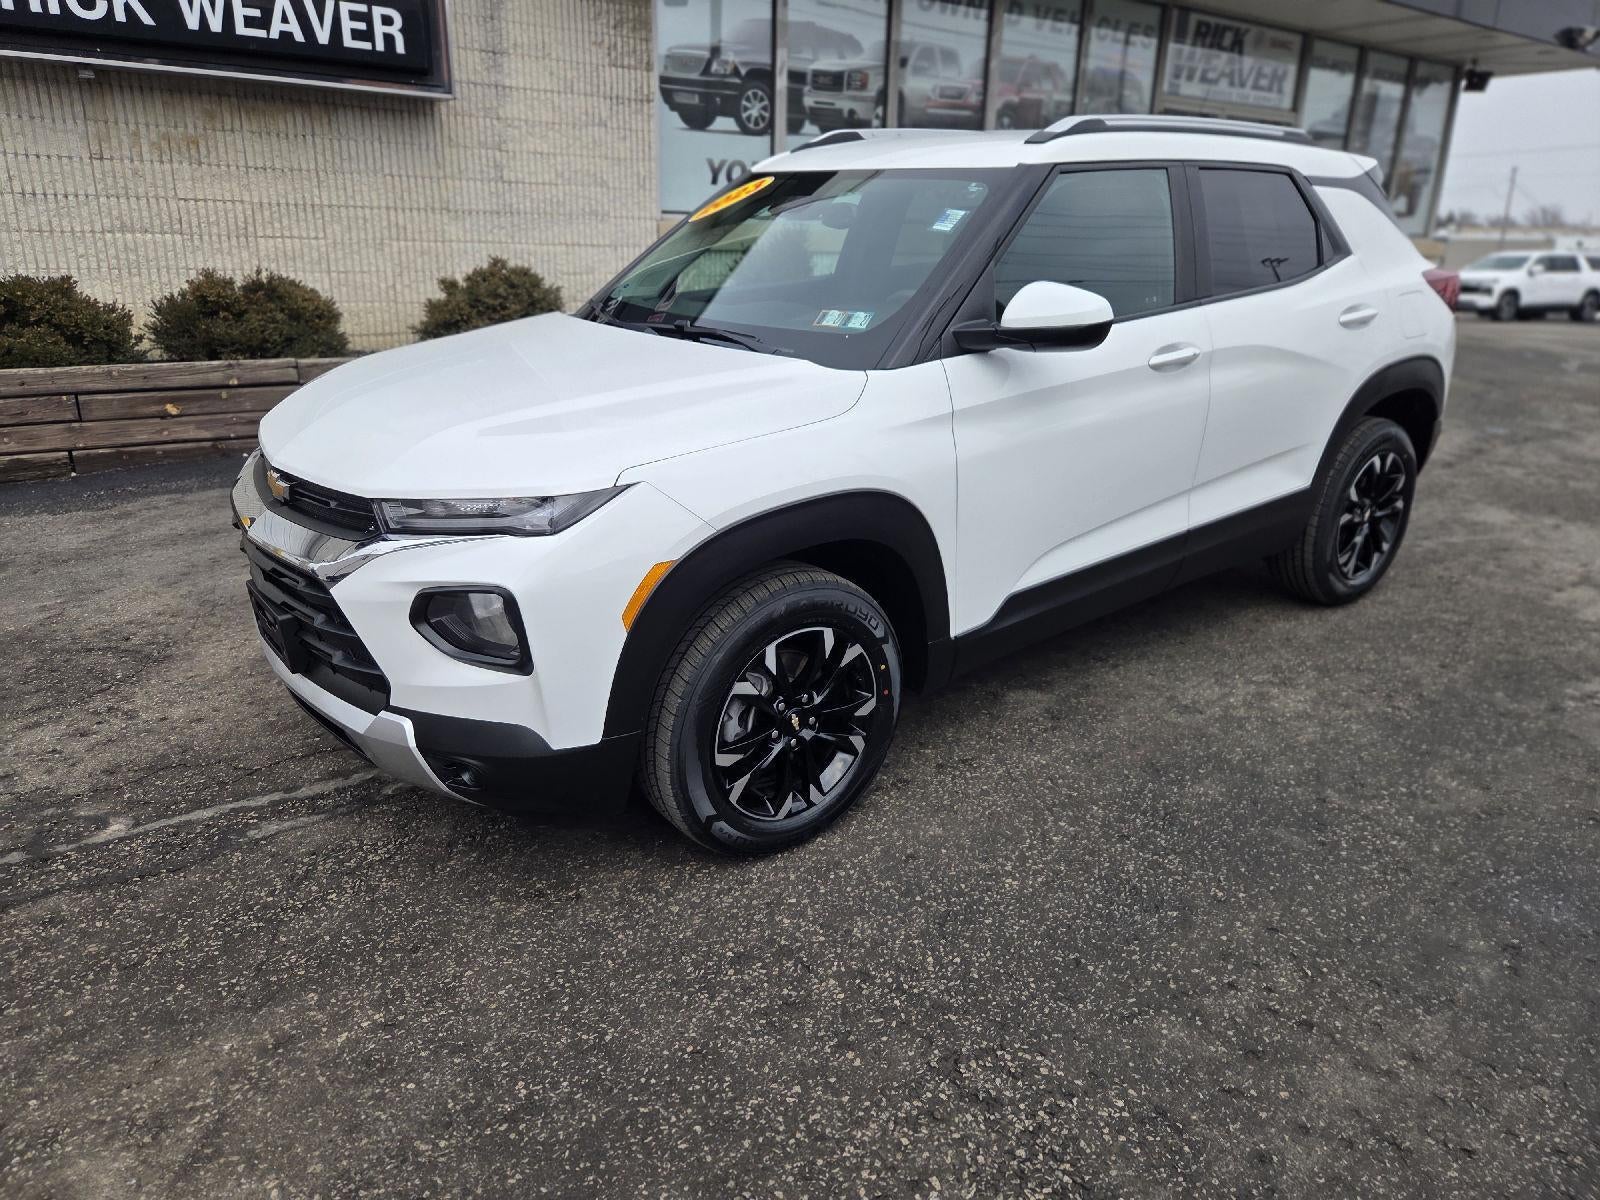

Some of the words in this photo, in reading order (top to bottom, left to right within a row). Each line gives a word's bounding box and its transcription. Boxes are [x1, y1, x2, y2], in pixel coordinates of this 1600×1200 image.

[178, 0, 406, 54] WEAVER
[1032, 3, 1155, 49] VECLES
[1191, 20, 1250, 55] RICK
[1172, 50, 1287, 94] WEAVER
[706, 157, 757, 185] YO
